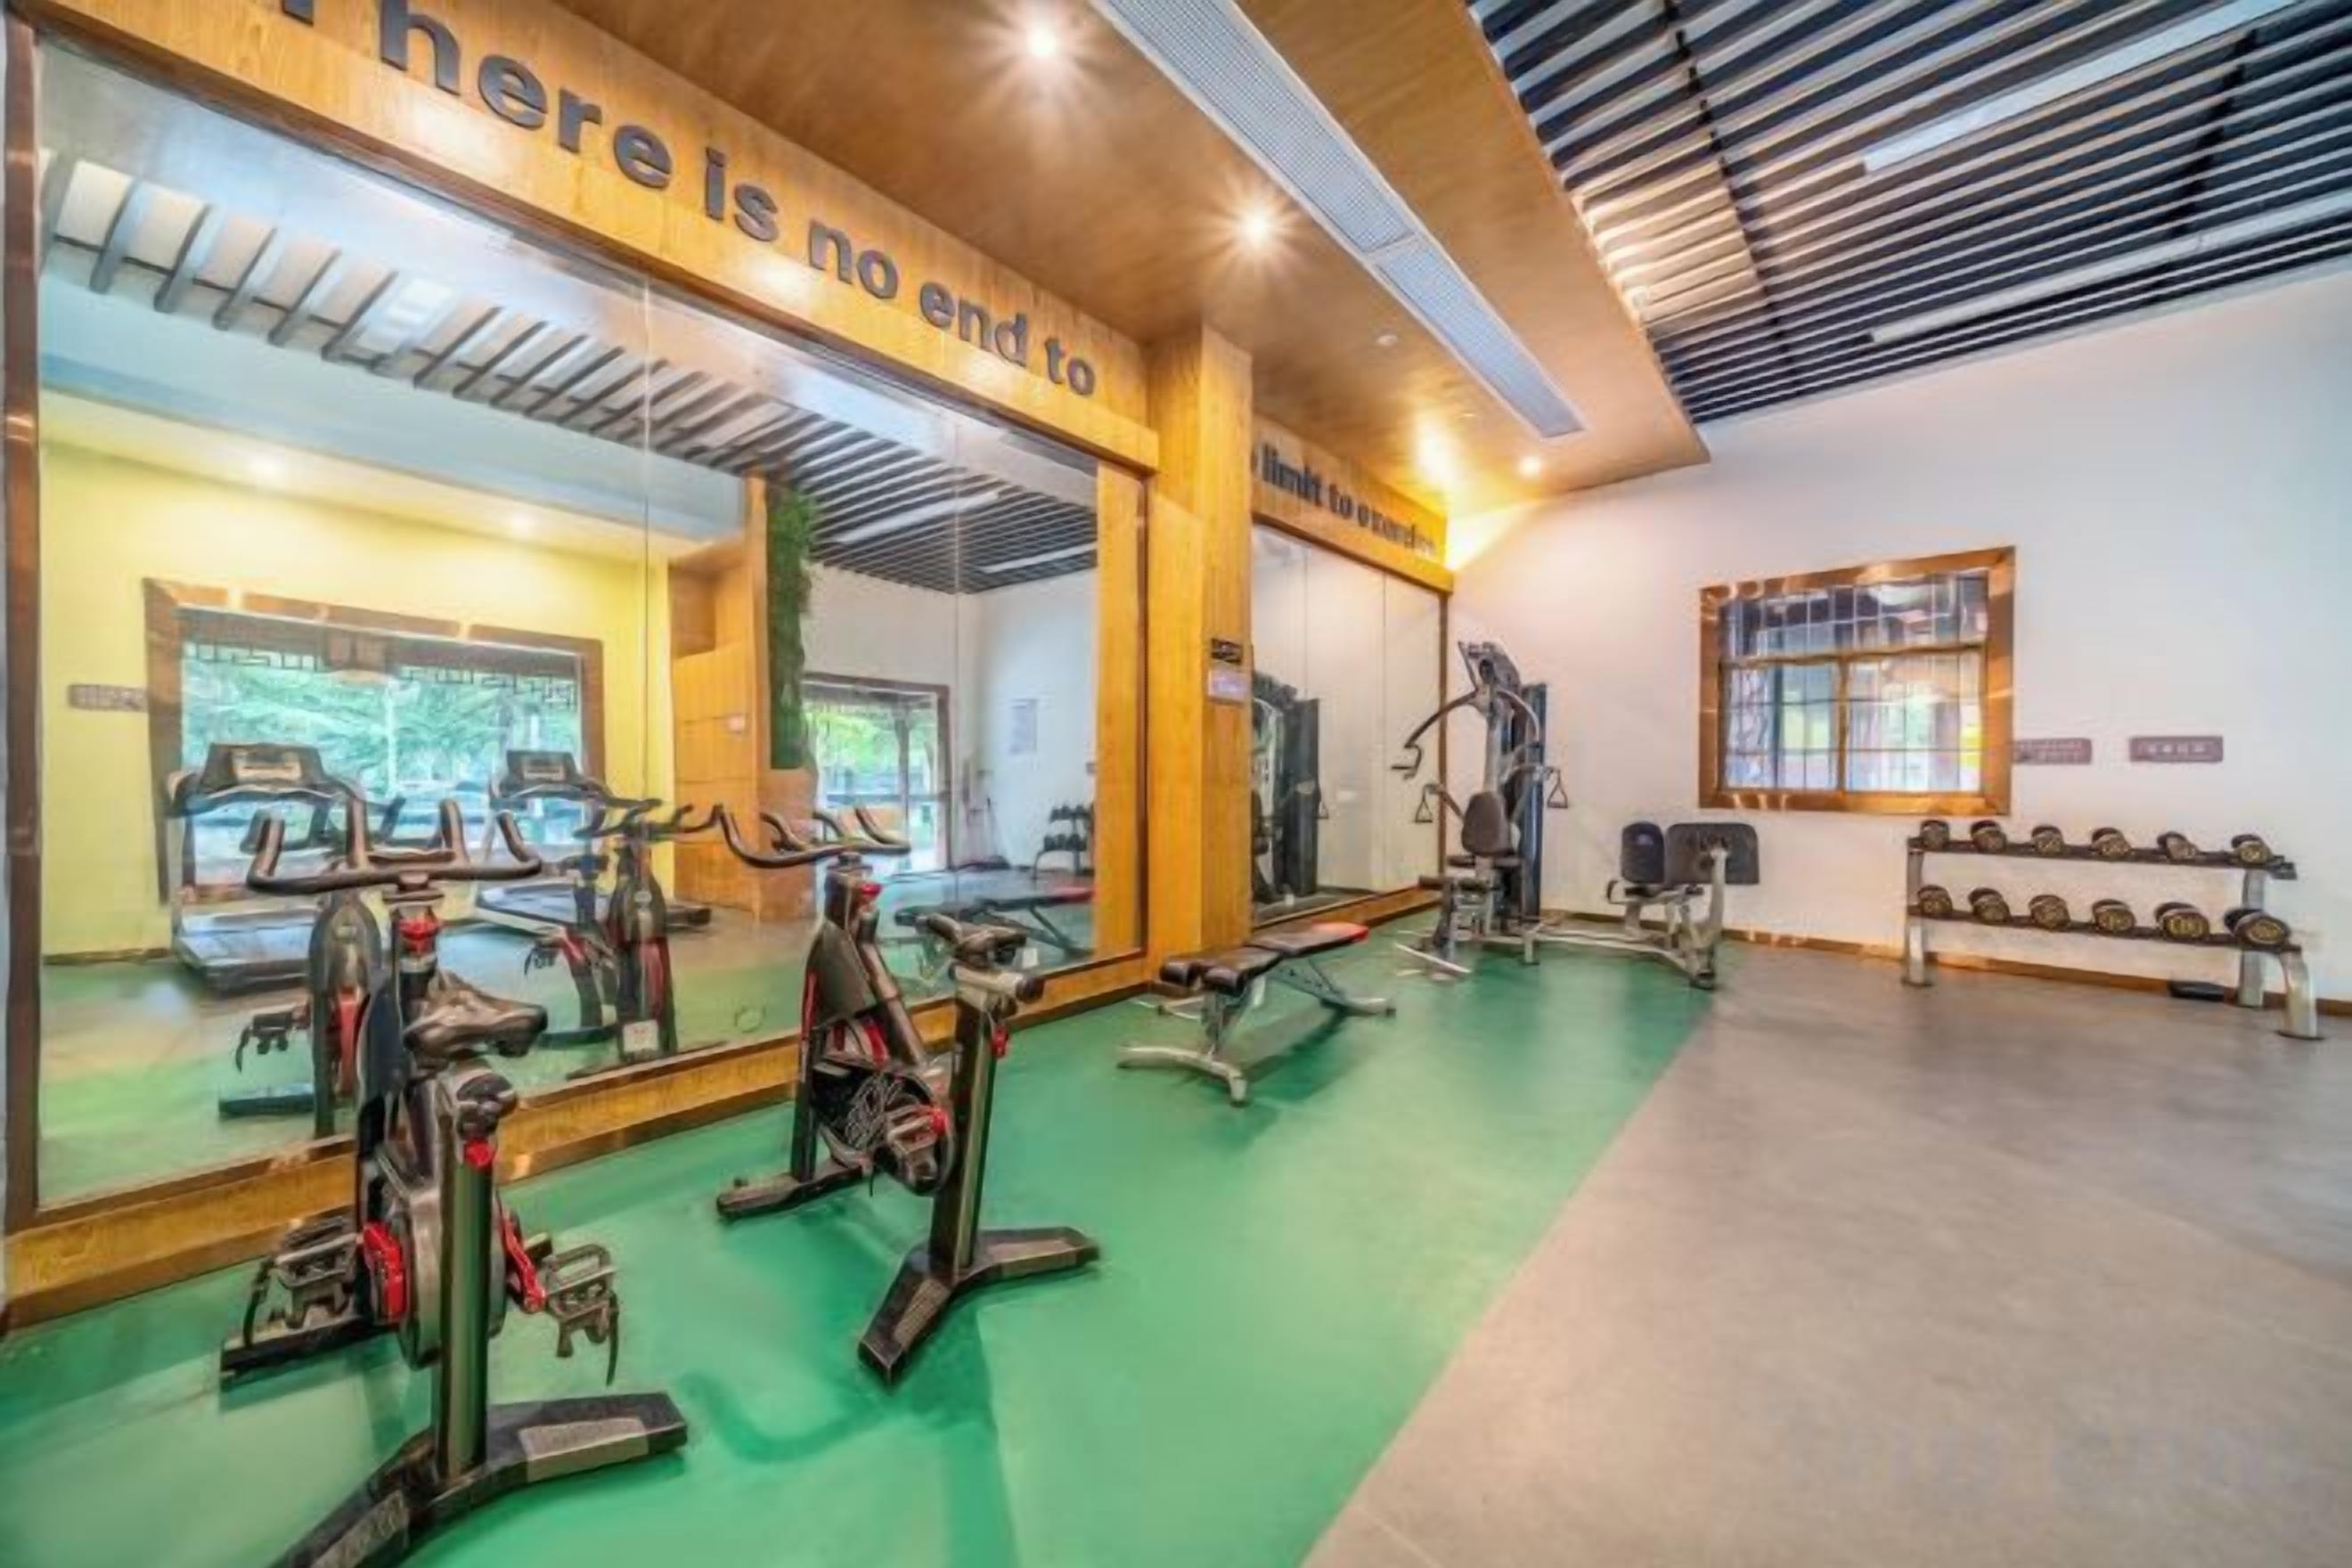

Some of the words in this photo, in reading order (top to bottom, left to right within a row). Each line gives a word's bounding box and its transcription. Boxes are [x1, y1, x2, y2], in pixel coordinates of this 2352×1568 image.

[282, 0, 673, 189] here
[704, 145, 780, 241] is
[808, 219, 899, 299] no
[919, 281, 1028, 368] end
[1044, 337, 1096, 396] to
[1329, 483, 1353, 519] to
